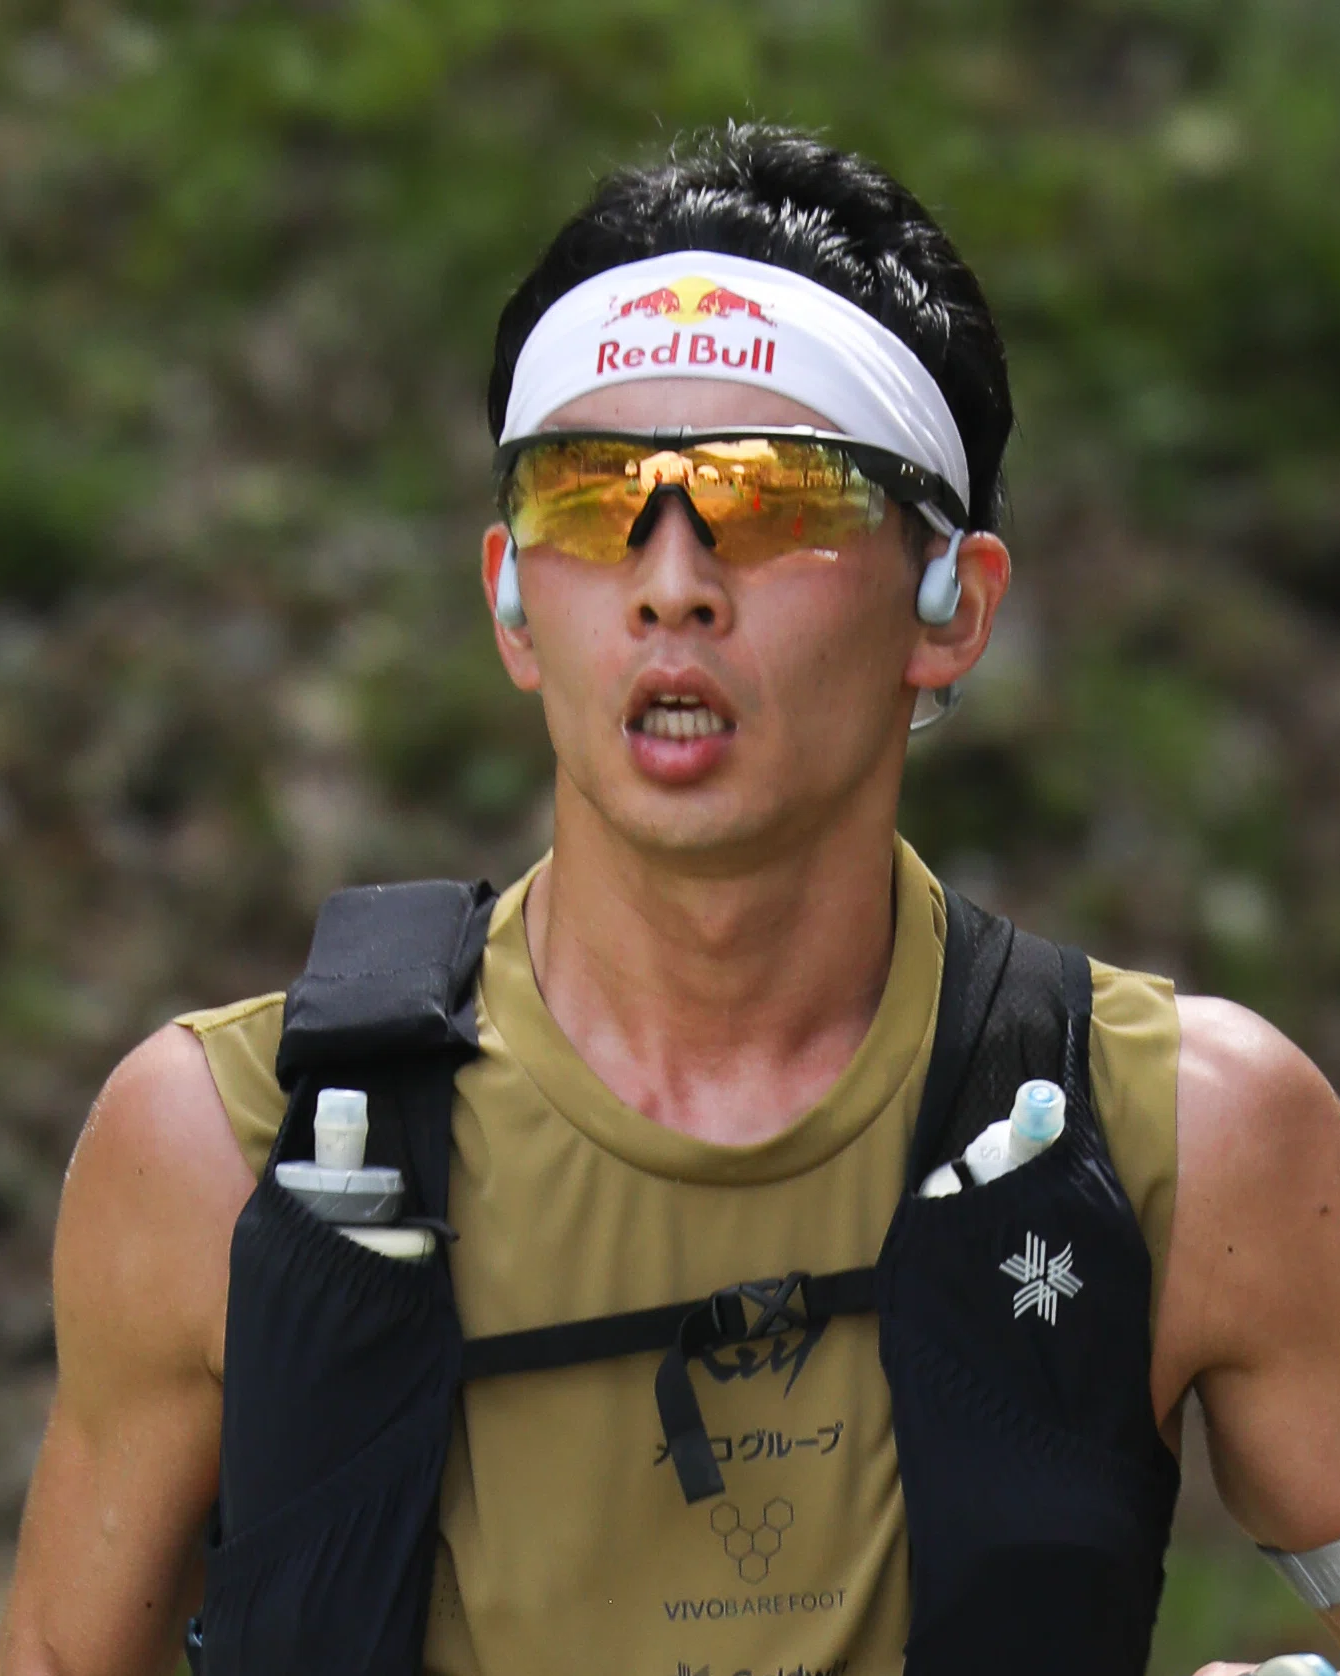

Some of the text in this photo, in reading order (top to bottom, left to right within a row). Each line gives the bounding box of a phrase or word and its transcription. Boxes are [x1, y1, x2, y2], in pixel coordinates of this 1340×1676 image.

[596, 332, 776, 375] Red Bull
[664, 1589, 847, 1622] VIVOBAREFOOT
